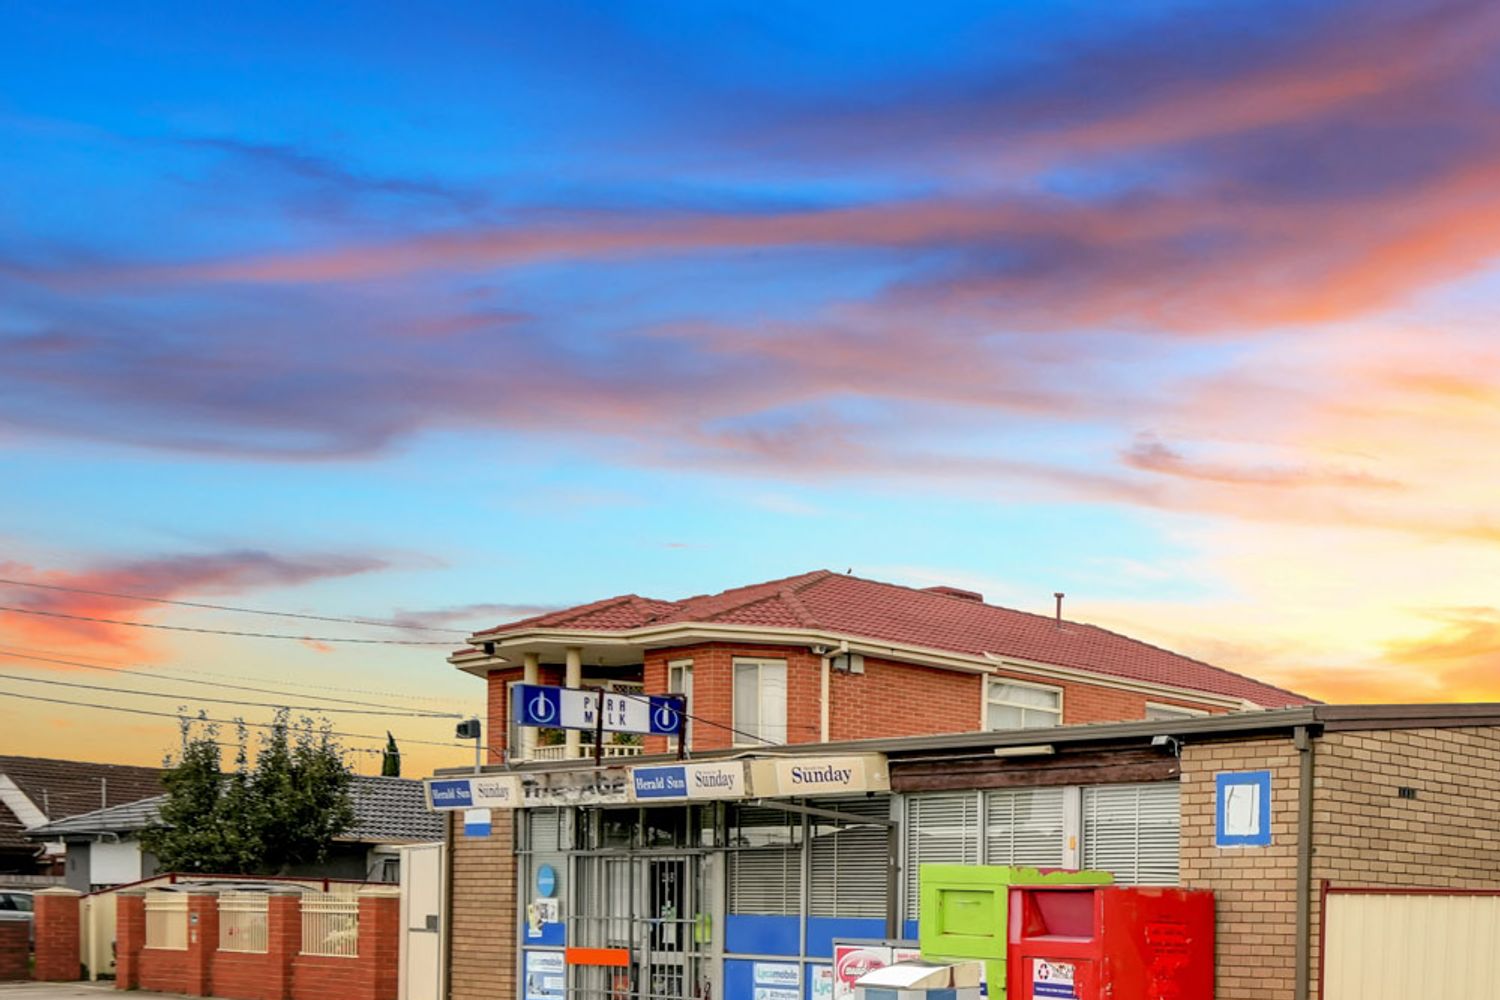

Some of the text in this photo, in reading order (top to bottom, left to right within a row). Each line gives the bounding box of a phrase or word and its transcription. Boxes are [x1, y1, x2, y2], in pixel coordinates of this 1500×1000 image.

[584, 711, 626, 726] MLK
[636, 775, 686, 790] Herald Sun
[694, 769, 736, 790] Sunday
[791, 765, 852, 785] Sunday
[456, 787, 471, 799] Sun
[478, 782, 510, 801] Sunday
